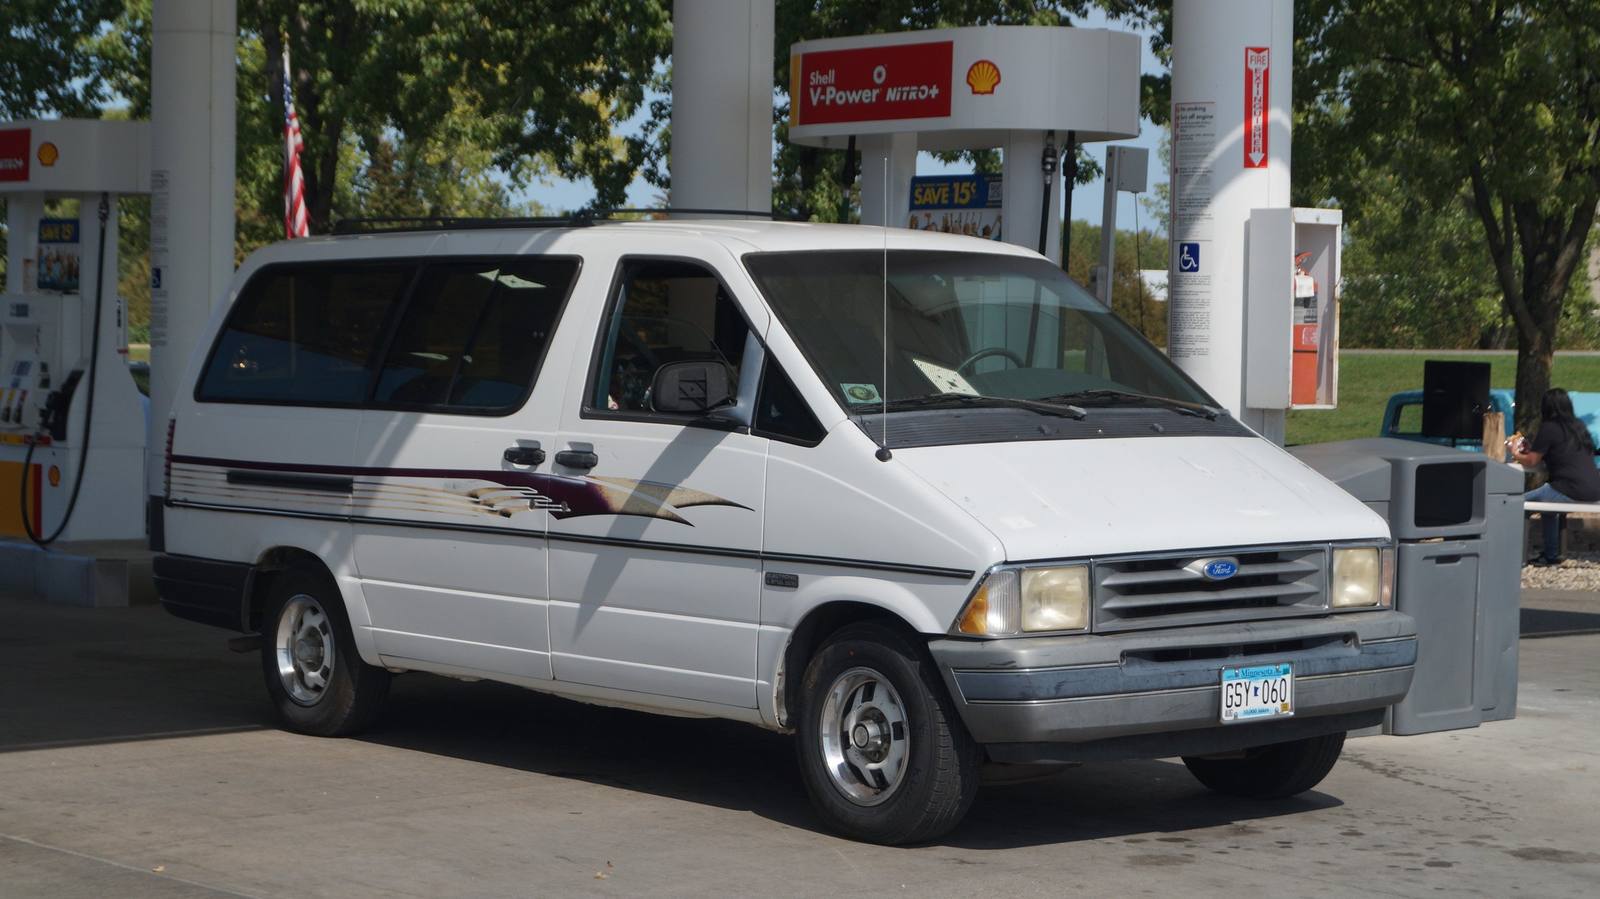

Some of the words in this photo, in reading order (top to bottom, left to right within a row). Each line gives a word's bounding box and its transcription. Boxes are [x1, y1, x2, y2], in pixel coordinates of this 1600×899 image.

[1249, 55, 1266, 65] FIRE
[809, 69, 835, 86] Shell
[809, 86, 880, 107] V-Power
[1253, 68, 1263, 153] EXTINGUISHER
[914, 183, 950, 205] SAVE
[1212, 563, 1232, 575] Ford
[1241, 668, 1273, 678] Minnesota
[1225, 681, 1251, 708] GSY
[1262, 678, 1287, 704] 060
